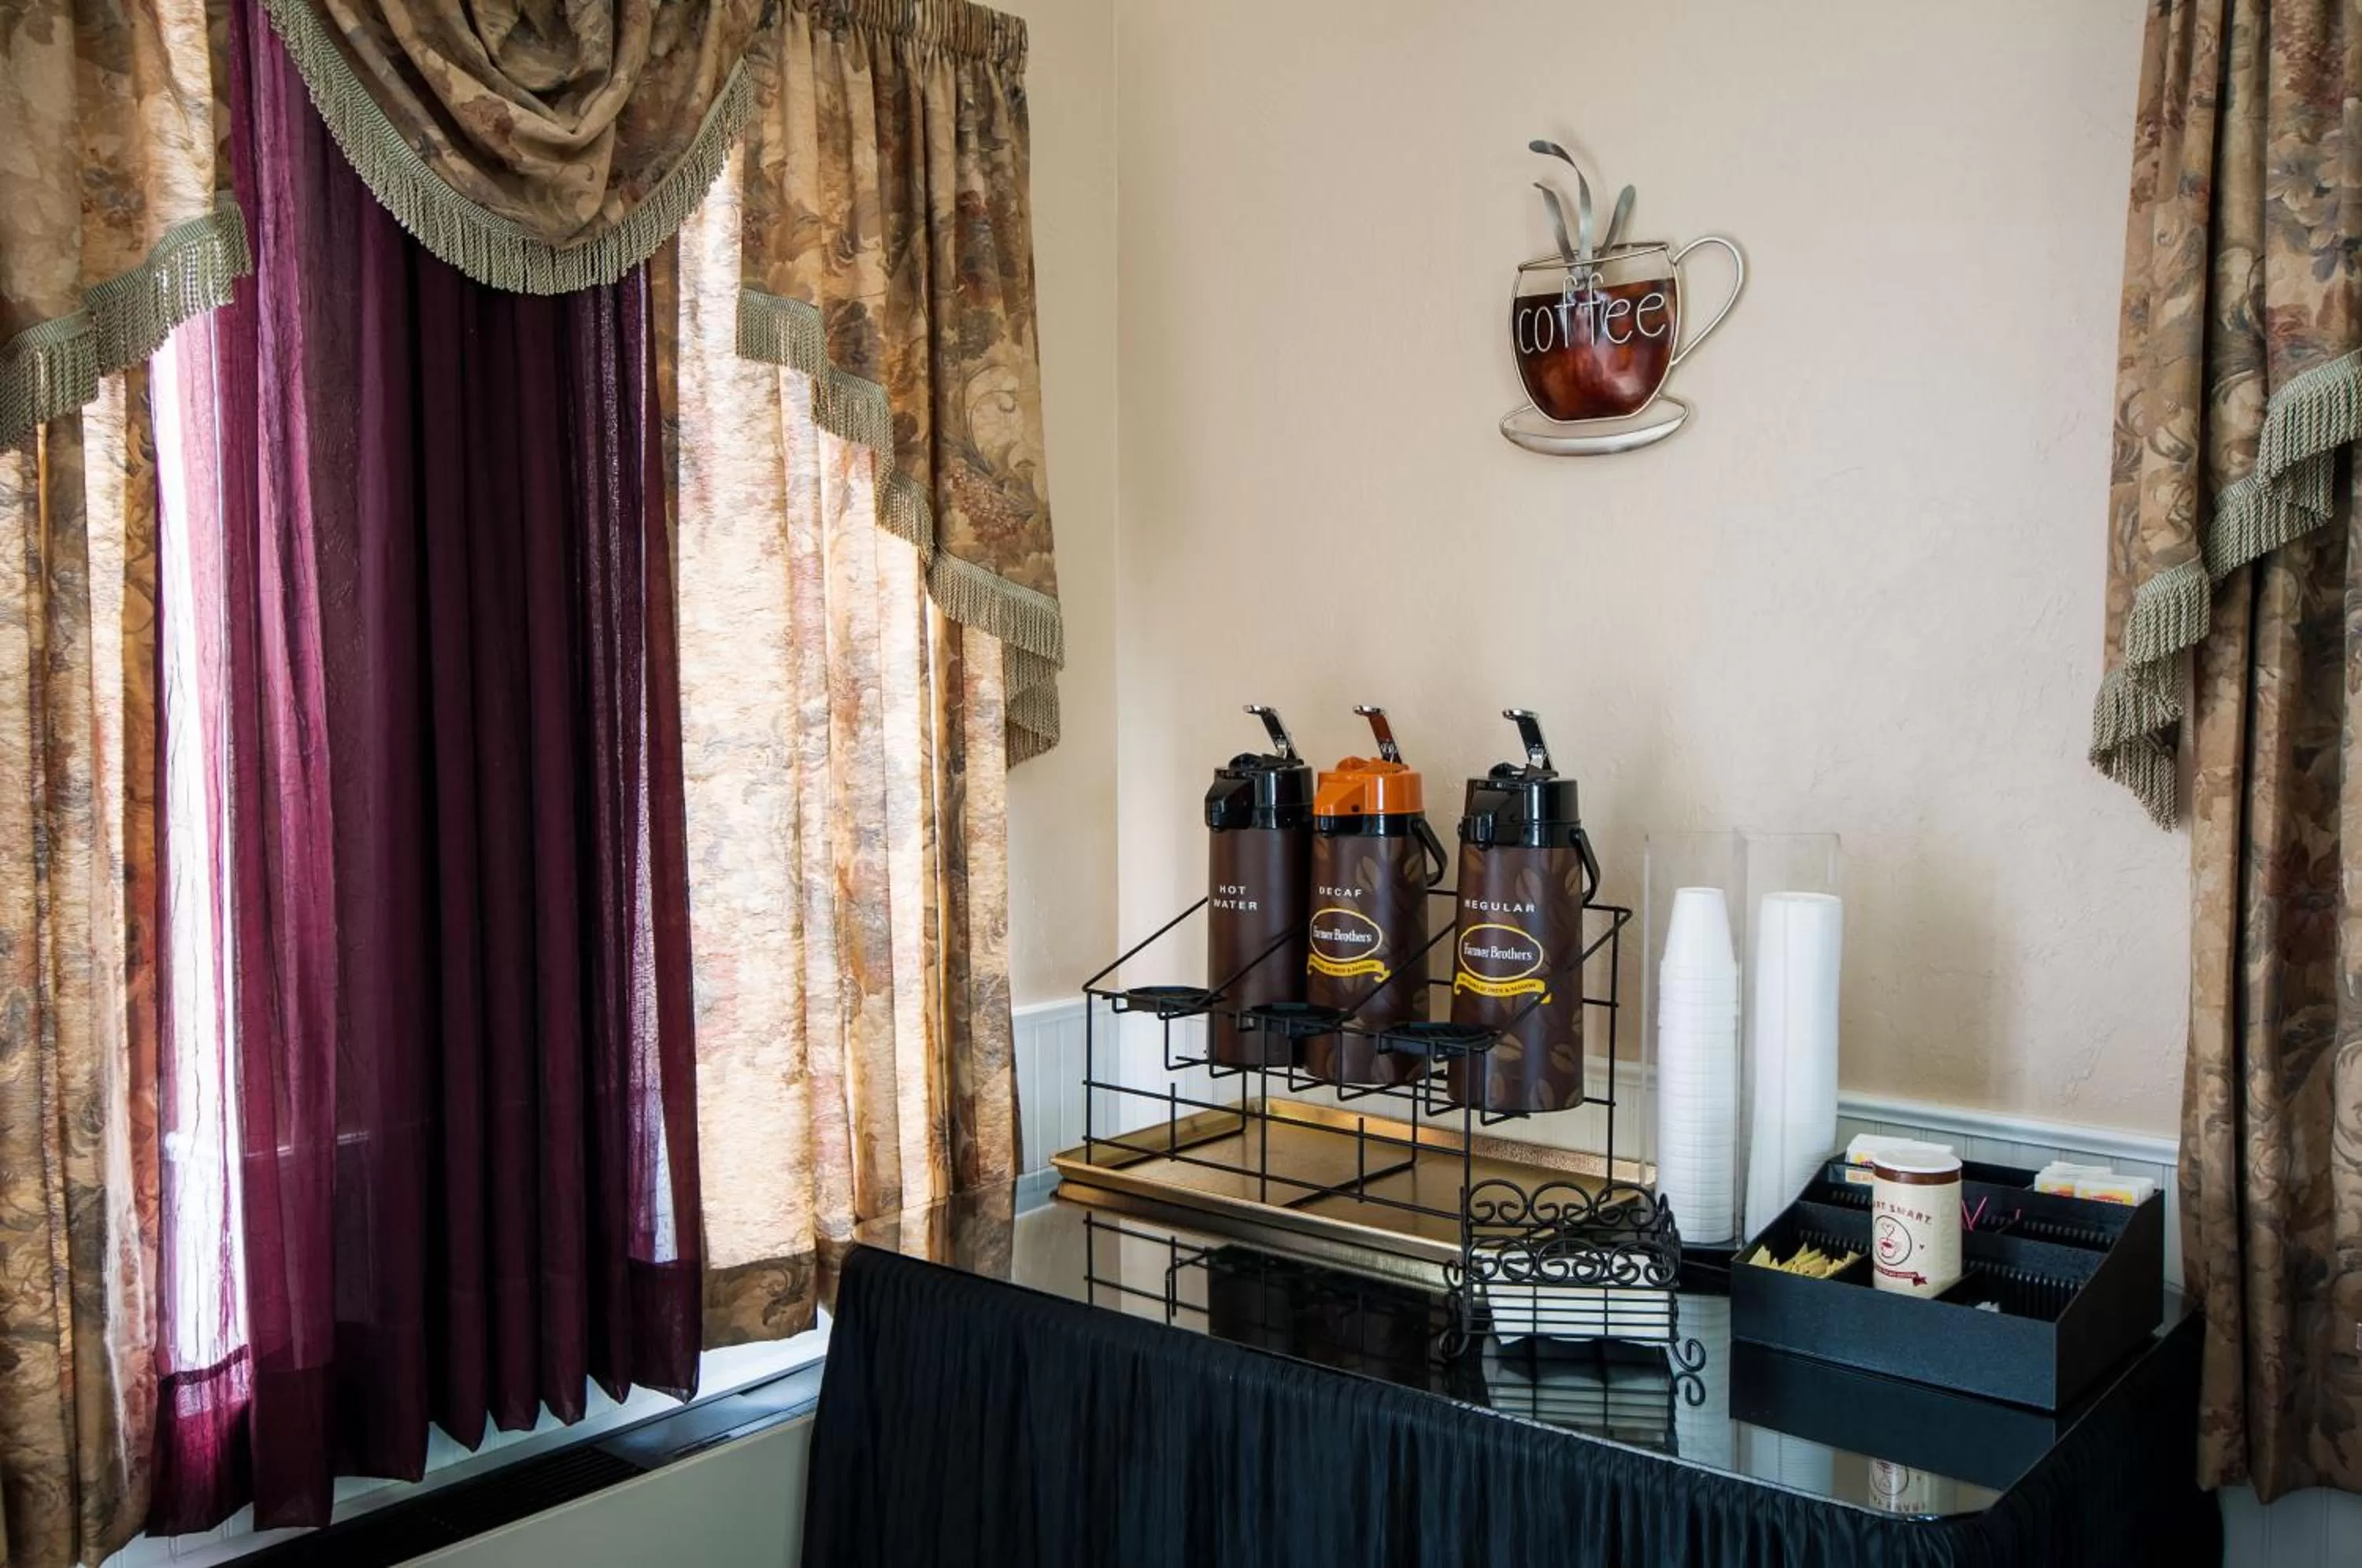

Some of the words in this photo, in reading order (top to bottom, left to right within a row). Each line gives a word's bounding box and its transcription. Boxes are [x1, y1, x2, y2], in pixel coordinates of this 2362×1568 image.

[1518, 272, 1666, 354] coffee
[1219, 884, 1246, 895] HOT
[1319, 886, 1363, 897] DECAF
[1213, 898, 1258, 911] WATER
[1464, 899, 1536, 913] REGULAR
[1334, 928, 1372, 943] Brothers
[1464, 941, 1490, 958] Farmer
[1490, 945, 1533, 961] Brothers
[1890, 1204, 1933, 1225] SMART
